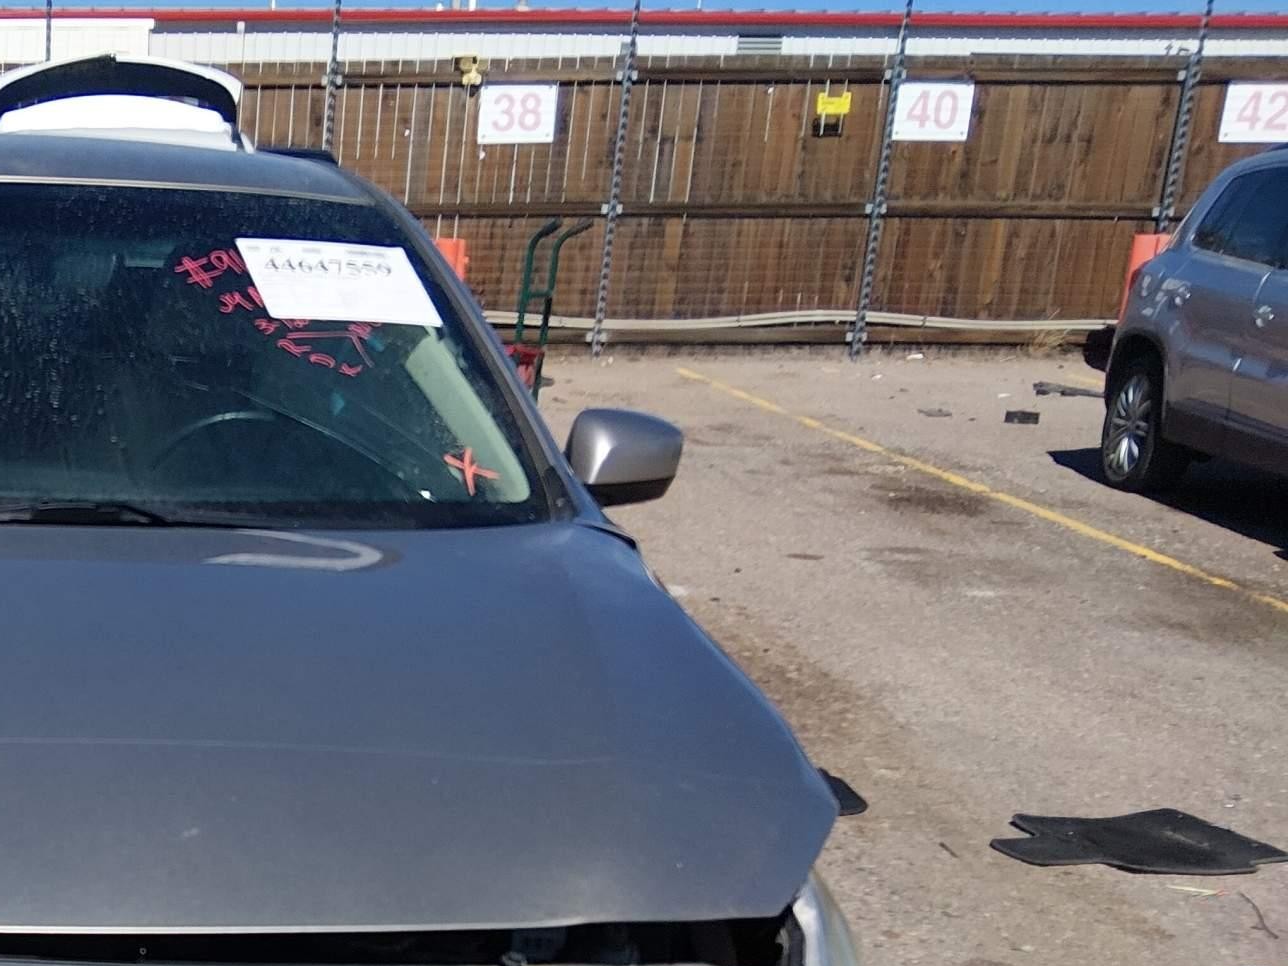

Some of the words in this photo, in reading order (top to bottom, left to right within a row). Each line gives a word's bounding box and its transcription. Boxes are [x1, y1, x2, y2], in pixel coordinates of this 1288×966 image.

[492, 92, 542, 132] 38
[907, 90, 959, 129] 40
[1236, 90, 1288, 131] 42
